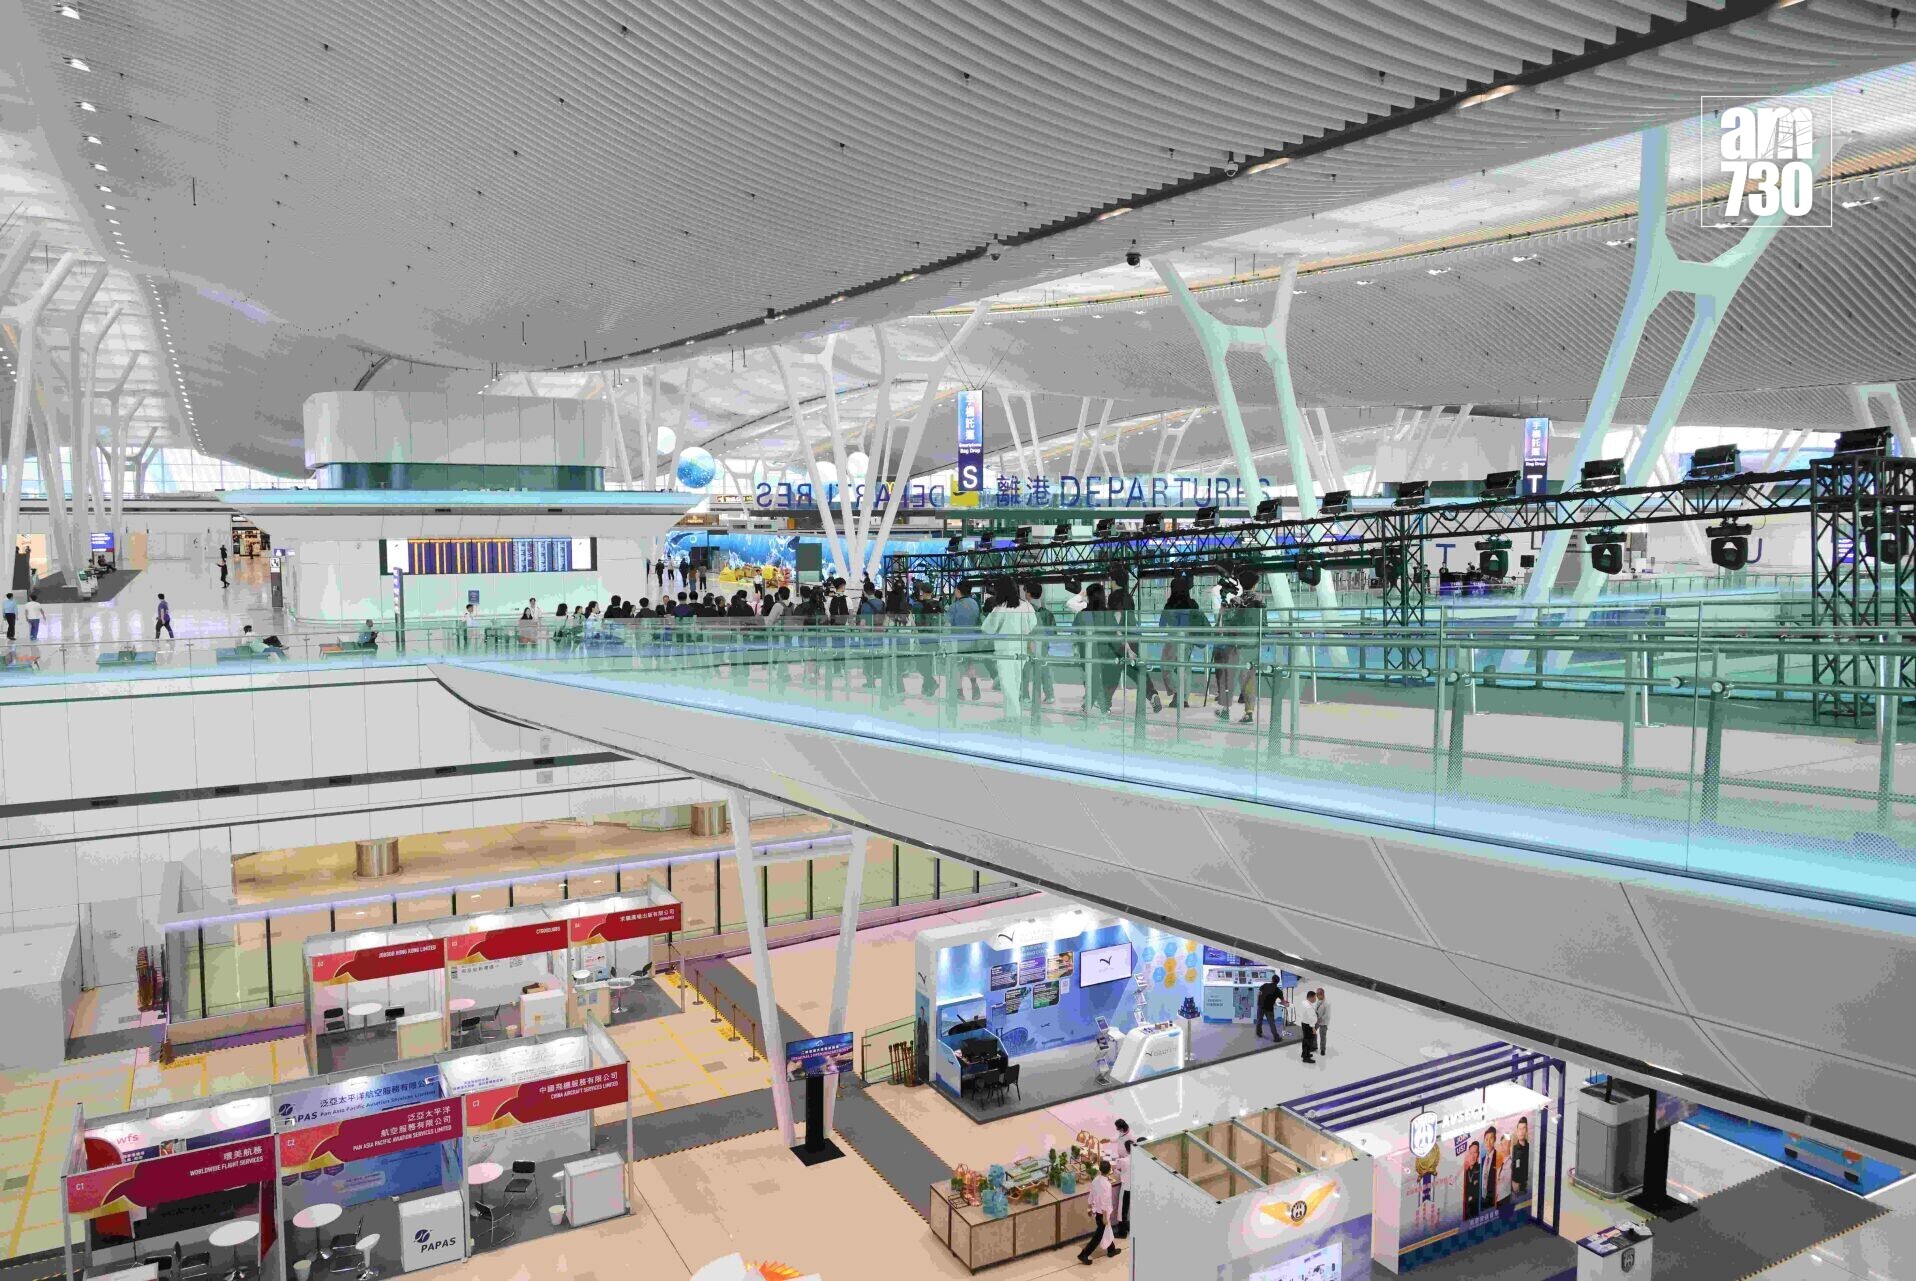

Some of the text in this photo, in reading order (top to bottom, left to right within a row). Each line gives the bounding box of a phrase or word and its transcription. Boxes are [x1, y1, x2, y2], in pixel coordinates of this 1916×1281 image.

[962, 465, 978, 489] S
[1526, 474, 1543, 494] T
[997, 474, 1051, 507] 離港
[550, 1091, 563, 1100] CHINA
[602, 1081, 618, 1091] LIMITED
[407, 1105, 451, 1123] 泛亞太平洋
[380, 1115, 451, 1138] 航空服務有限公司
[116, 1133, 139, 1145] wfs
[352, 1143, 362, 1152] PAN
[363, 1141, 374, 1150] ASIA
[375, 1138, 392, 1148] PACIFIC
[413, 1129, 434, 1140] SERVICES
[434, 1124, 452, 1136] LIMITED
[189, 1155, 264, 1177] WORLDWIDE FLIGHT SERVICES
[75, 1183, 84, 1191] C1
[420, 1237, 456, 1253] PAPAS
